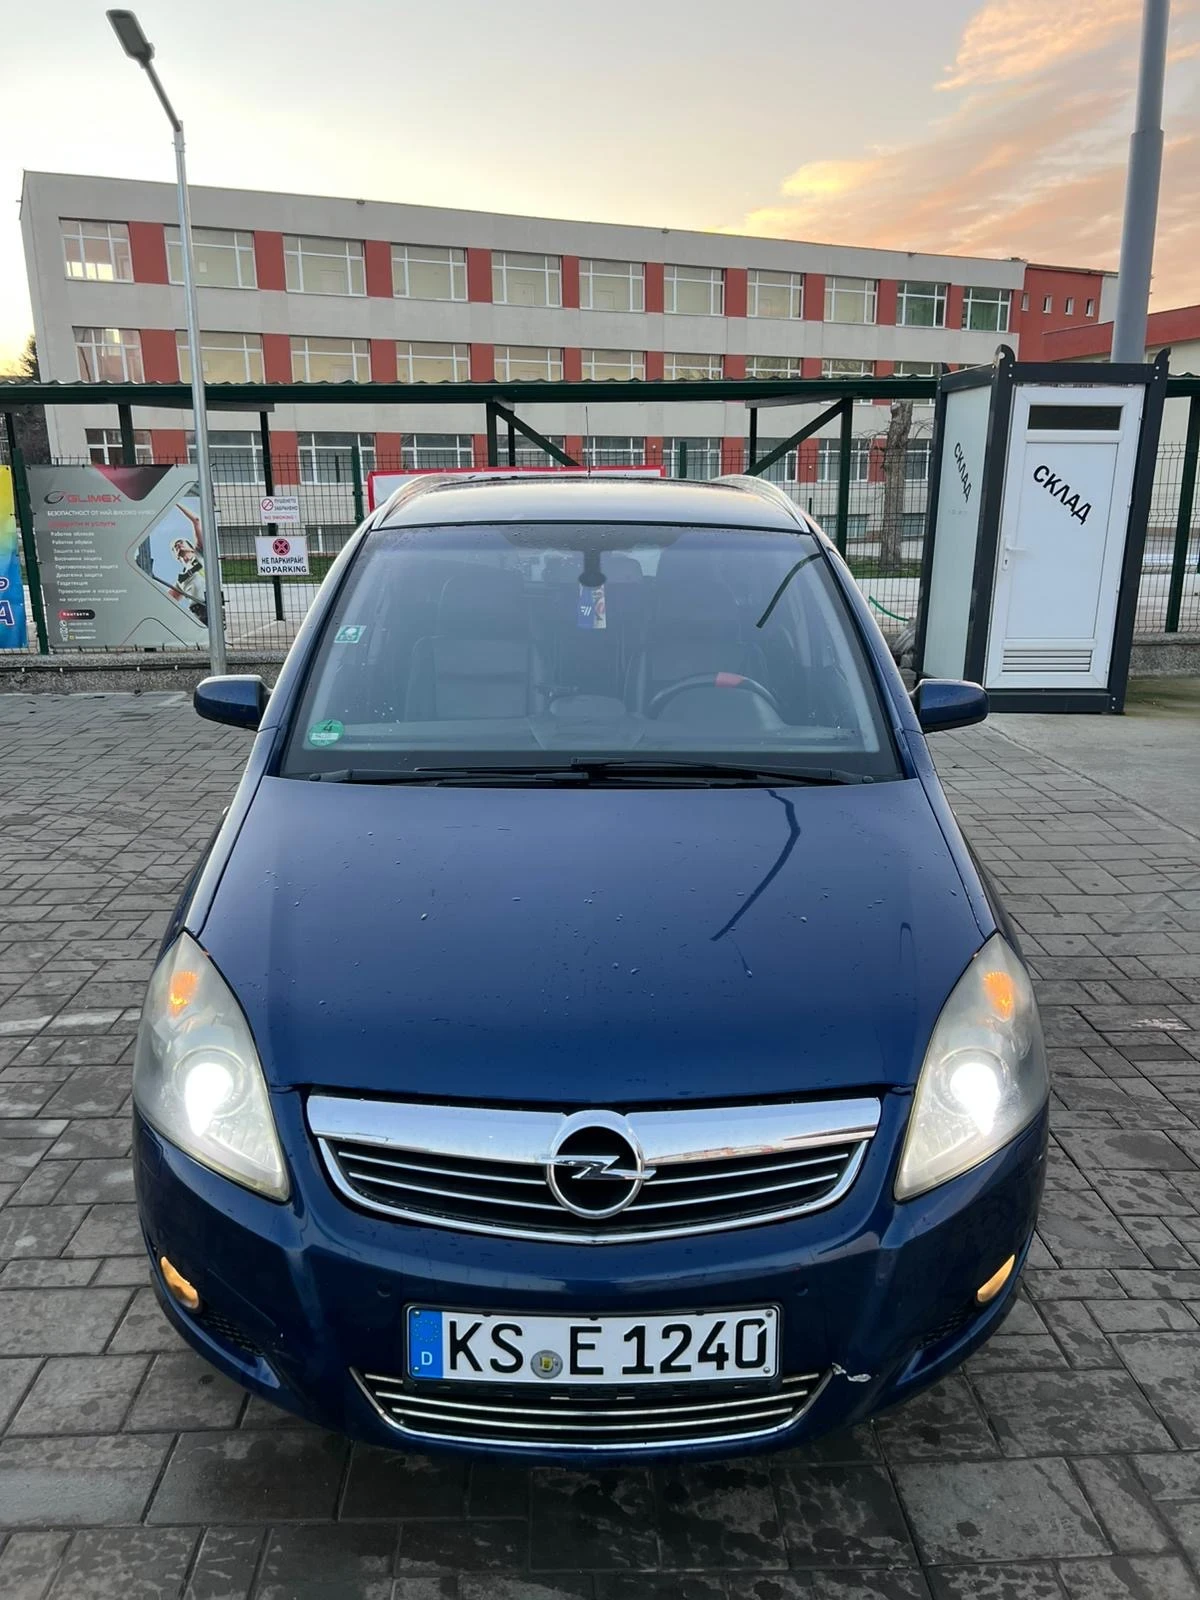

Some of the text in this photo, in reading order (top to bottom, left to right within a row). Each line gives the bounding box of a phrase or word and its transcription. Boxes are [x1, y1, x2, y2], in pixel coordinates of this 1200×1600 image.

[954, 442, 972, 503] СКЛАД
[67, 494, 121, 503] GLIMEX
[1033, 465, 1092, 526] СКЛАД
[270, 555, 304, 564] ПАРКИРАЙ!
[323, 720, 333, 731] 4
[448, 1318, 768, 1375] KS E 1240
[420, 1351, 433, 1366] D
